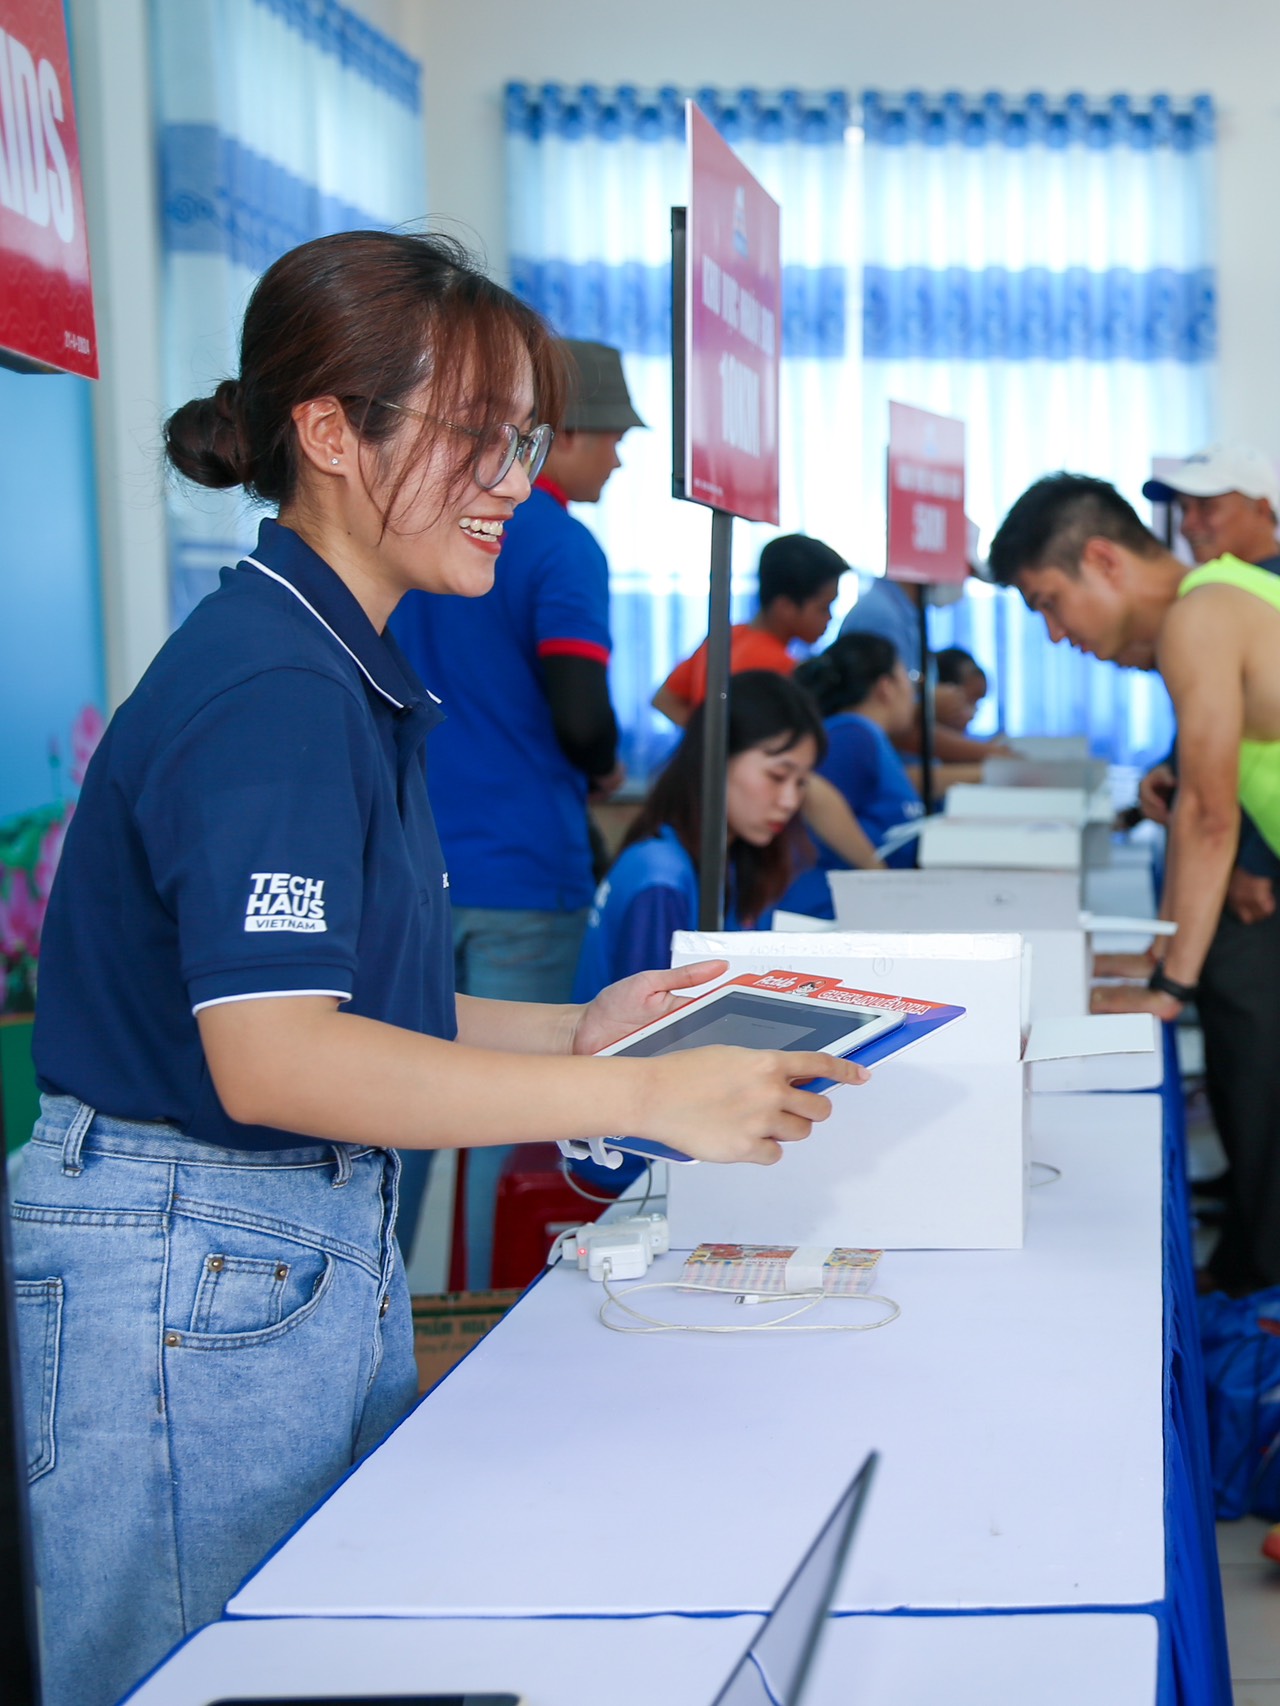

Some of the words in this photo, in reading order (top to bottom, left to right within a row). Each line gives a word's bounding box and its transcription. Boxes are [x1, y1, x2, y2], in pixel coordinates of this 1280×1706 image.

[0, 27, 74, 244] IDS
[250, 872, 325, 900] TECH
[246, 894, 325, 920] HAUS
[255, 918, 316, 931] VIETNAM
